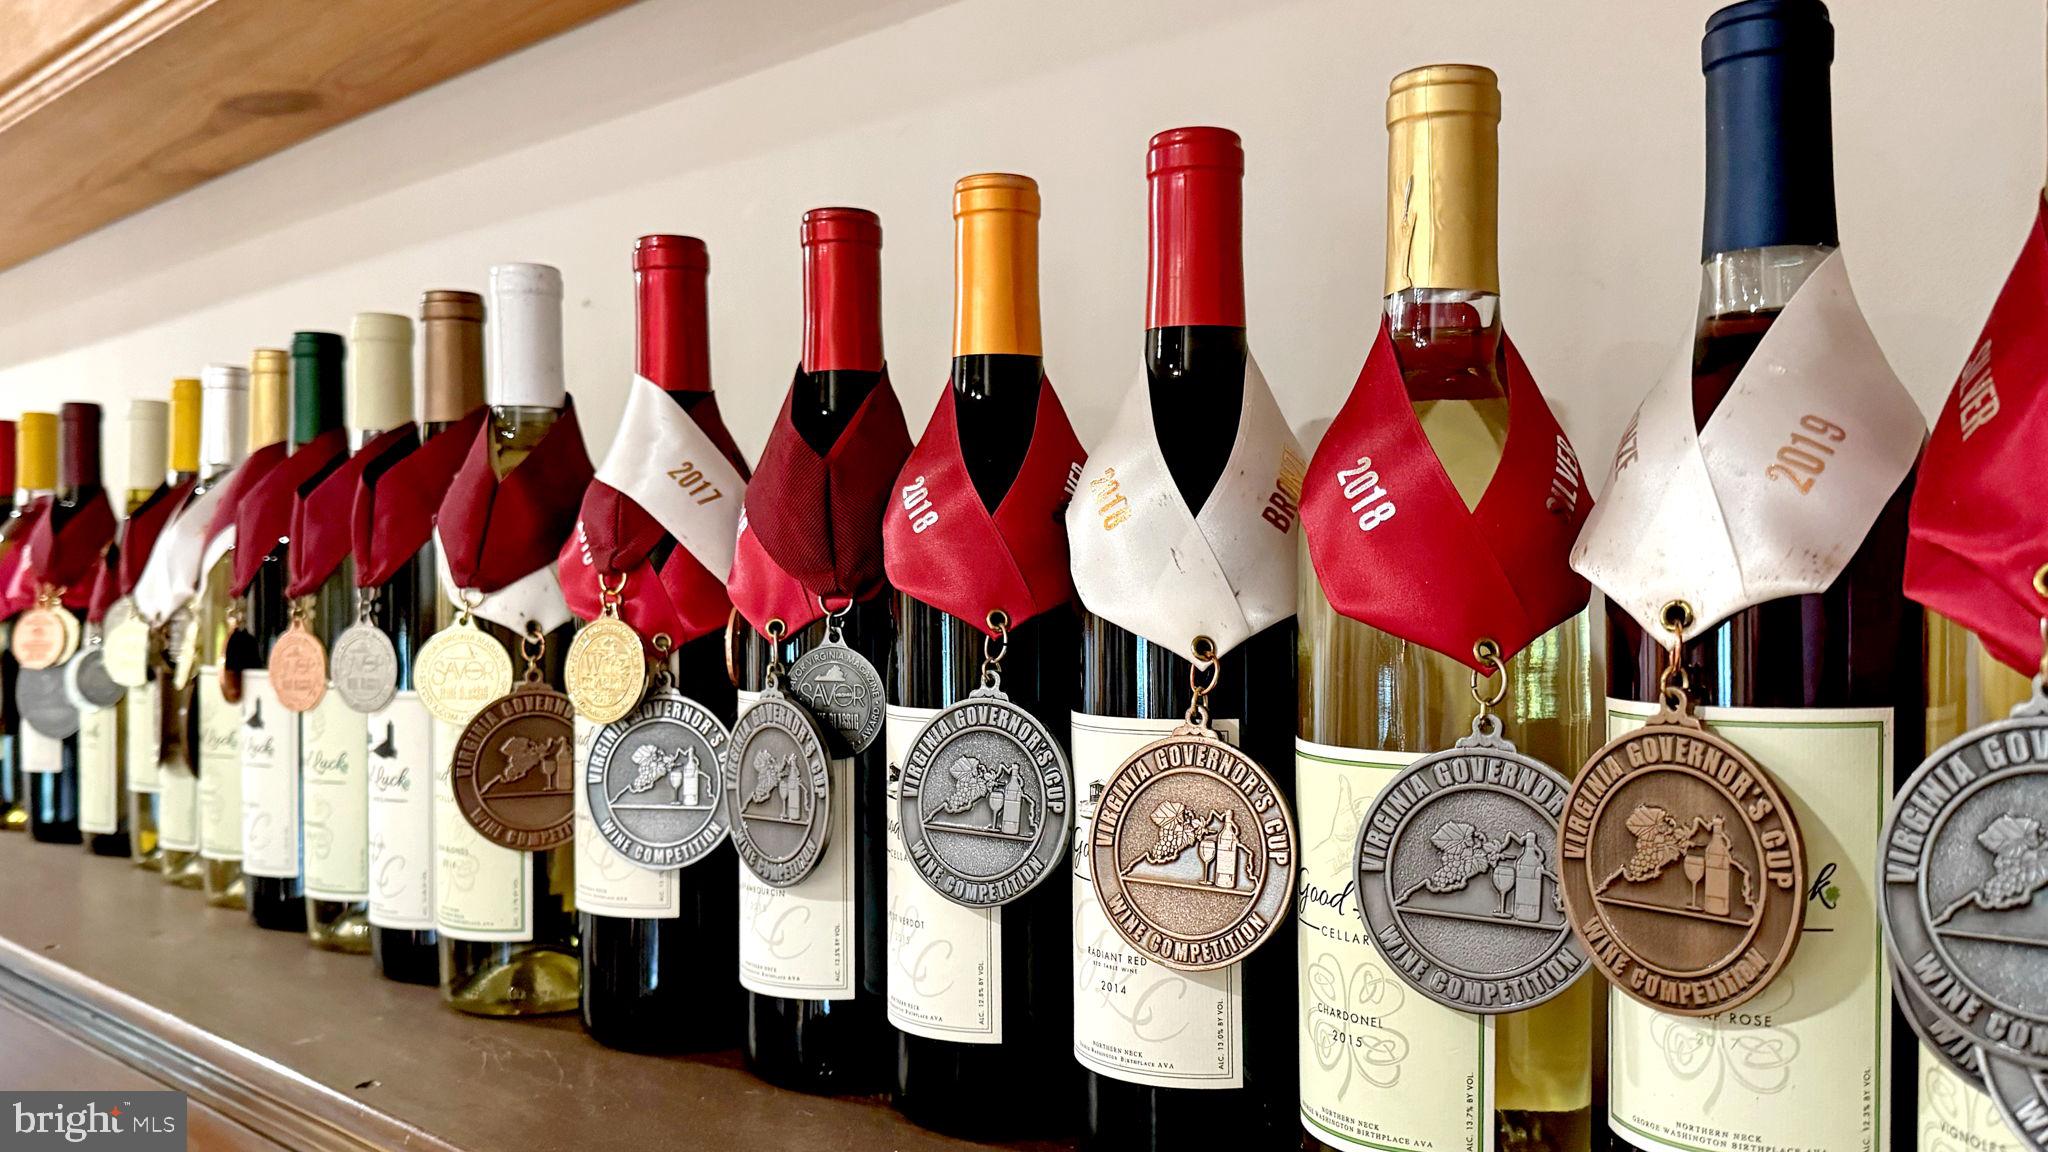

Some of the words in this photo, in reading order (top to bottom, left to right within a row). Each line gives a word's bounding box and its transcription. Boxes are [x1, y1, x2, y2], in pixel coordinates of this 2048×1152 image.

[1765, 414, 1847, 496] 2019
[667, 461, 723, 506] 2017
[902, 476, 939, 534] 2018
[1337, 456, 1397, 532] 2018
[806, 651, 844, 666] VIRGINIA
[847, 655, 880, 698] MAGAZINE
[800, 682, 866, 708] SAVOR
[456, 711, 499, 778] VIRGINIA
[861, 706, 880, 741] AWARD
[588, 721, 632, 784] VIRGINIA
[902, 722, 952, 798] VIRGINIA
[955, 704, 1054, 768] GOVERNOR'S
[1043, 767, 1066, 815] CUP
[1096, 761, 1152, 847] VIRGINIA
[1155, 744, 1275, 814] GOVERNOR'S
[1264, 818, 1291, 867] CUP
[1361, 773, 1432, 873] VIRGINIA
[1433, 756, 1565, 818] GOVERNOR
[1564, 755, 1627, 860] VIRGINIA
[1626, 734, 1773, 823] GOVERNOR'S
[1760, 829, 1795, 889] CUP
[1886, 752, 1978, 884] VIRGINIA
[601, 819, 633, 853] WINE
[634, 821, 722, 864] COMPETITION
[910, 840, 945, 884] WINE
[944, 854, 1044, 905] COMPETITION
[1107, 892, 1149, 943] WINE
[1151, 911, 1269, 964] COMPETITION
[1088, 945, 1122, 964] RADIANT
[1128, 955, 1147, 966] RED
[1378, 924, 1431, 980] WINE
[1430, 947, 1582, 1007] COMPETITION
[1582, 915, 1632, 976] WINE
[1630, 946, 1769, 1006] COMPETITION
[1101, 980, 1127, 995] 2014
[1913, 951, 1985, 1024] WINE
[1217, 1017, 1224, 1027] BY
[1317, 1003, 1384, 1028] CHARDONEL
[1729, 1012, 1772, 1028] ROSE
[1124, 1049, 1143, 1058] NECK
[1332, 1030, 1362, 1047] 2015
[1321, 1106, 1355, 1124] NORTHERN
[1358, 1120, 1379, 1131] NECK
[1466, 1093, 1474, 1103] BY
[1357, 1127, 1410, 1145] BIRTHPLACE
[1413, 1140, 1433, 1148] AVA
[1663, 1126, 1727, 1148] WASHINGTON
[1675, 1121, 1729, 1138] NORTHERN
[1733, 1133, 1762, 1143] NECK
